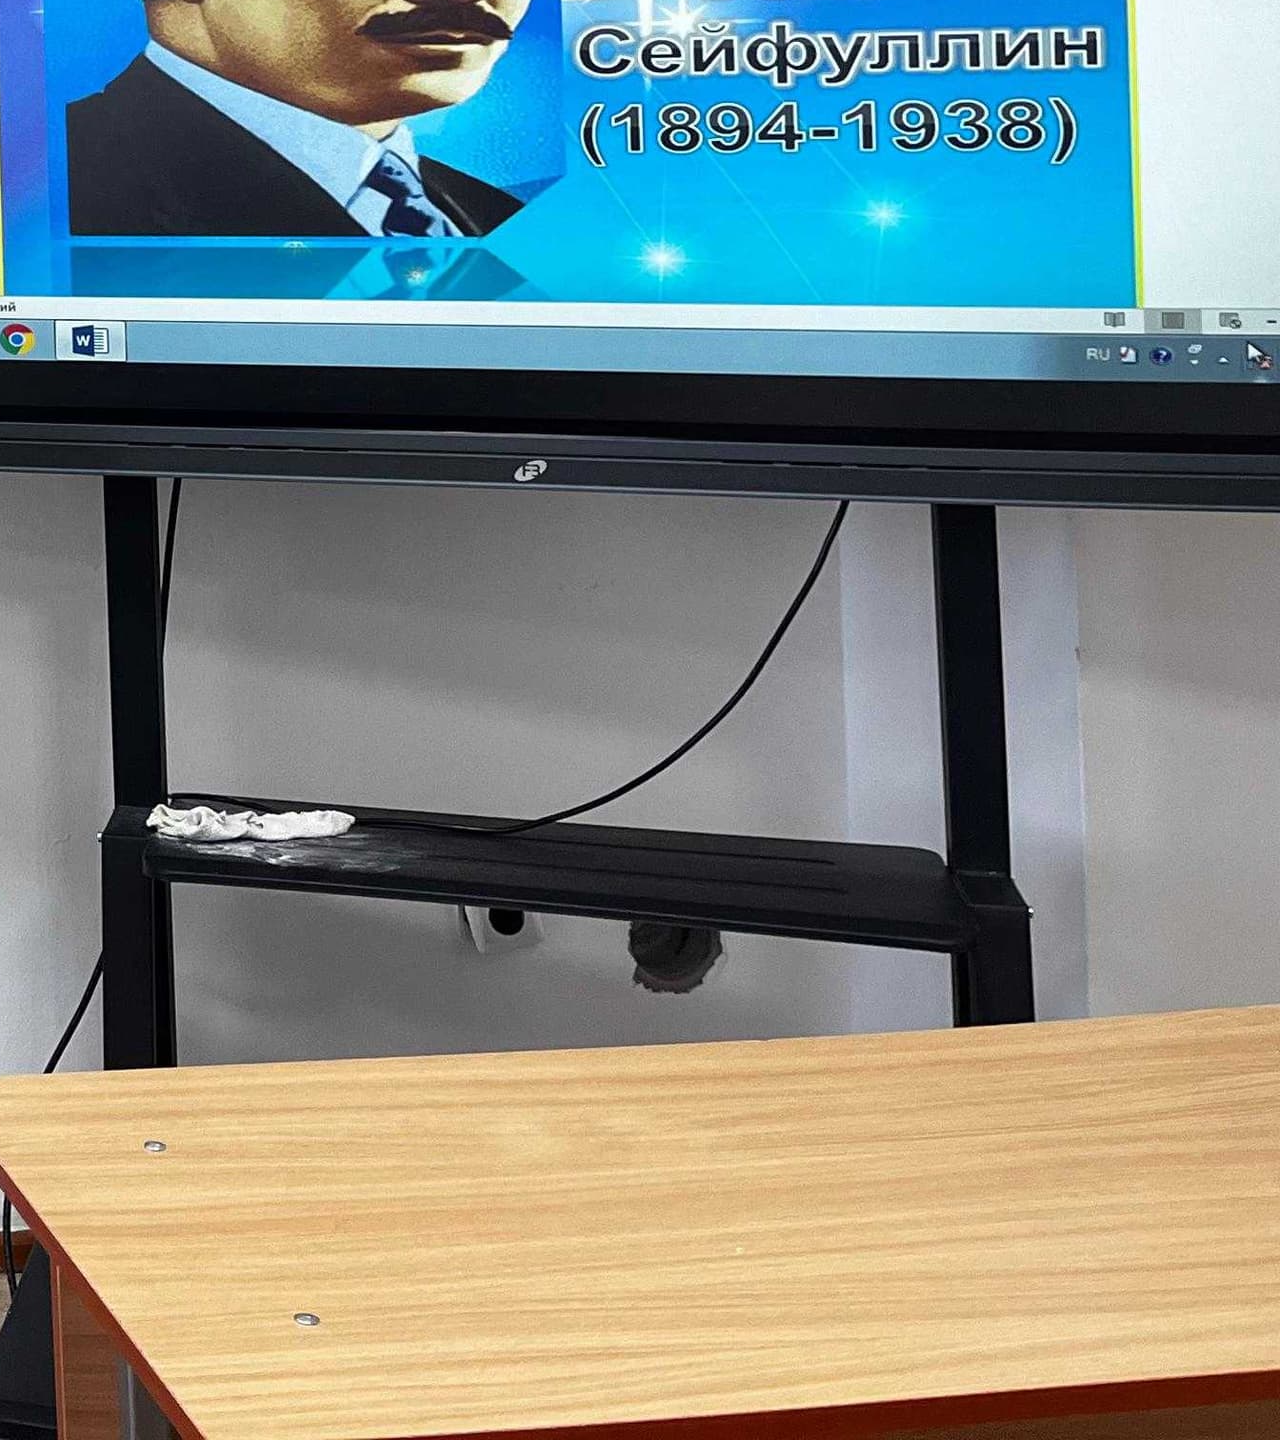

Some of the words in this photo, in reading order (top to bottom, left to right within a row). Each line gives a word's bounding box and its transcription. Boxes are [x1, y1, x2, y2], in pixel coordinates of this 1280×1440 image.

[577, 22, 1102, 87] Сейфуллин
[579, 98, 1078, 167] (1894-1938)
[76, 335, 90, 347] W
[1086, 347, 1110, 362] RU
